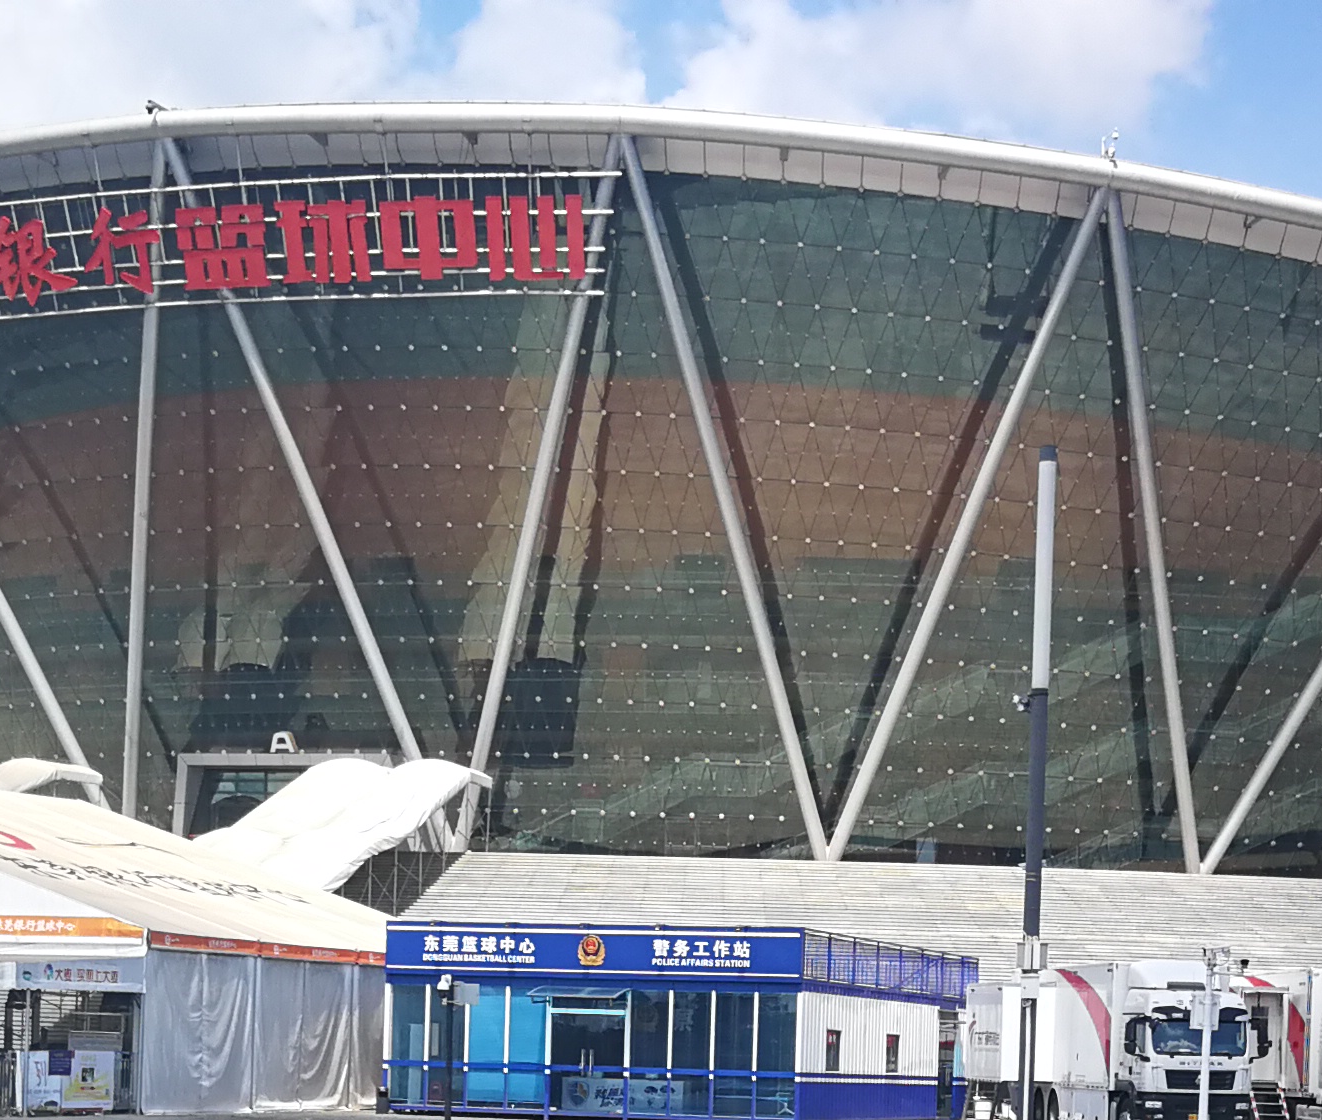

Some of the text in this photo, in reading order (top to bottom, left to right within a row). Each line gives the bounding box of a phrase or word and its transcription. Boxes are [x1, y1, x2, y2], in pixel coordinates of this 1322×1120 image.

[270, 731, 298, 753] A
[423, 934, 535, 954] 东莞篮球中心
[652, 939, 751, 958] 警务工作站
[464, 953, 507, 963] BASKETBALL
[507, 955, 536, 964] CENTER
[651, 958, 751, 968] POLICE AFFAIRS STATION
